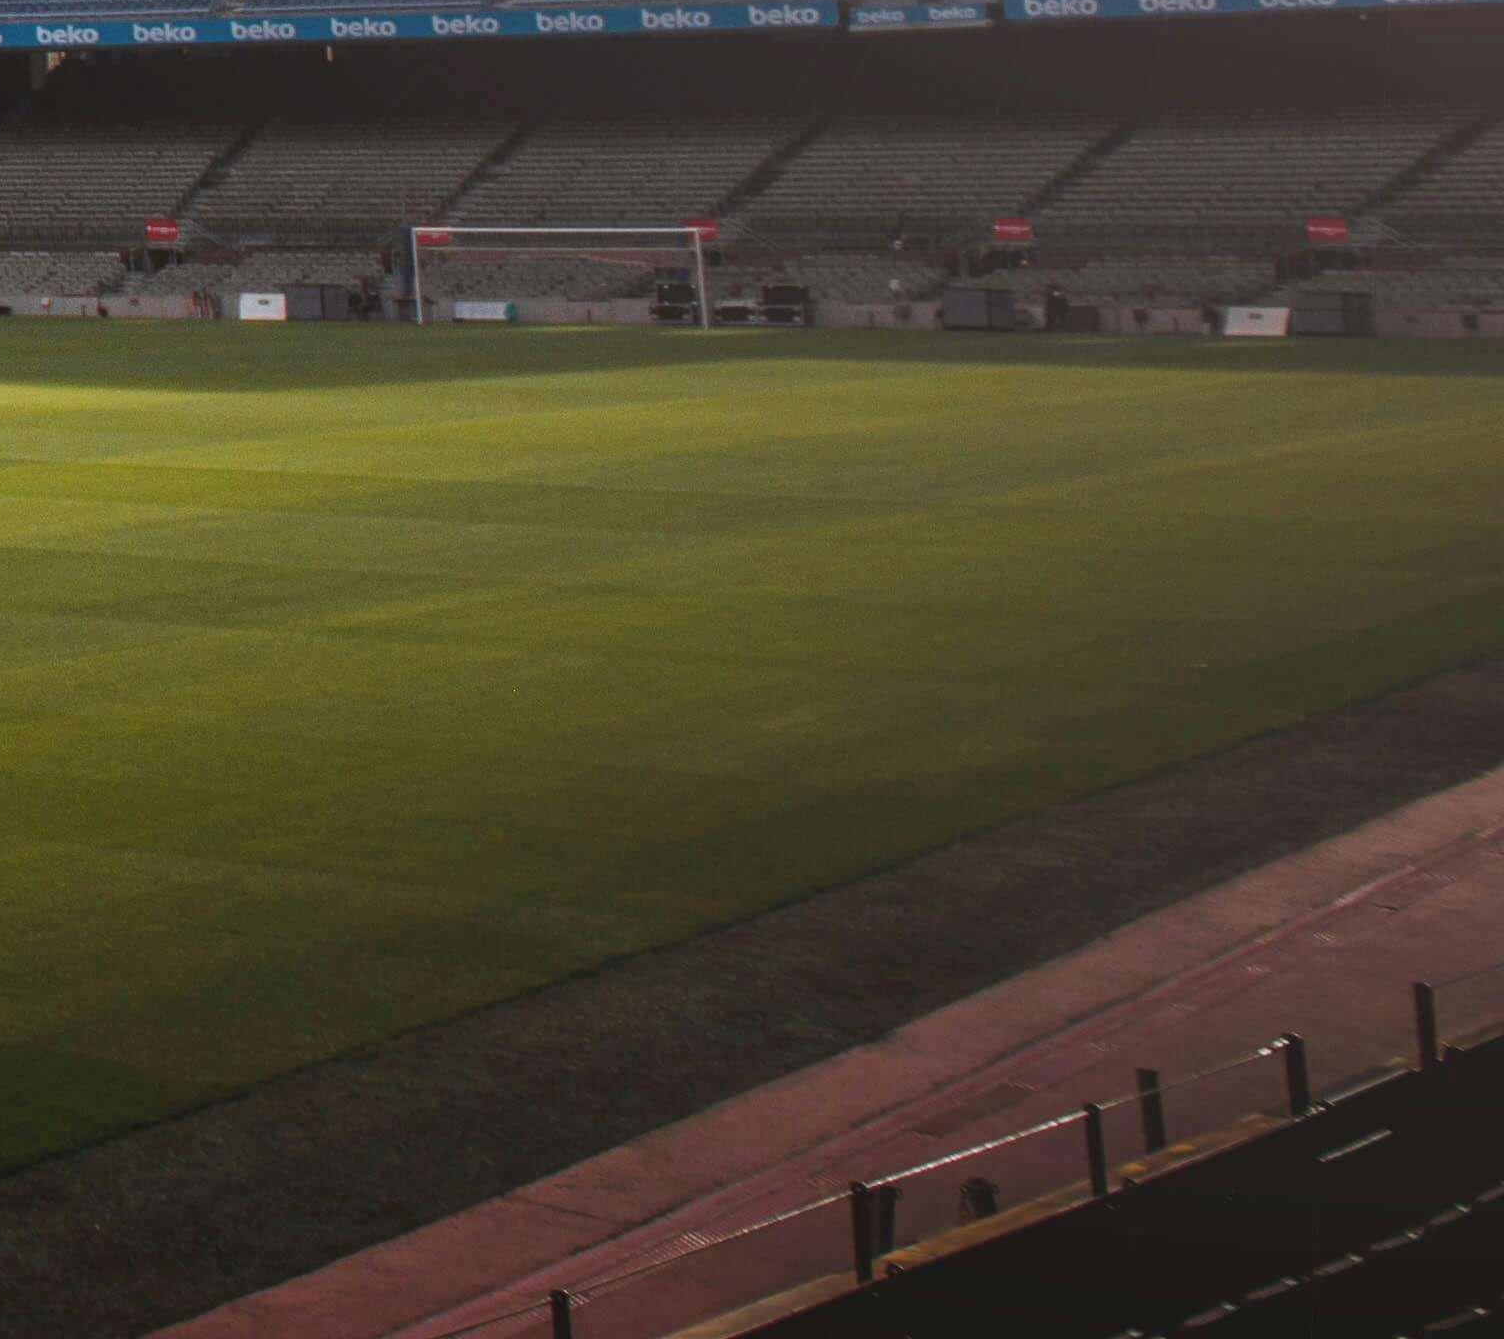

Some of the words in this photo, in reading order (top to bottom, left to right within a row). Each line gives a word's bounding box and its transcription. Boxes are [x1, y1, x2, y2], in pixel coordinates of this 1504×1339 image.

[432, 13, 498, 34] beko
[536, 10, 603, 32] beko
[641, 7, 710, 28] beko
[748, 5, 819, 26] beko
[36, 25, 98, 45] beko
[133, 23, 195, 43] beko
[231, 20, 294, 40] beko
[331, 17, 396, 37] beko
